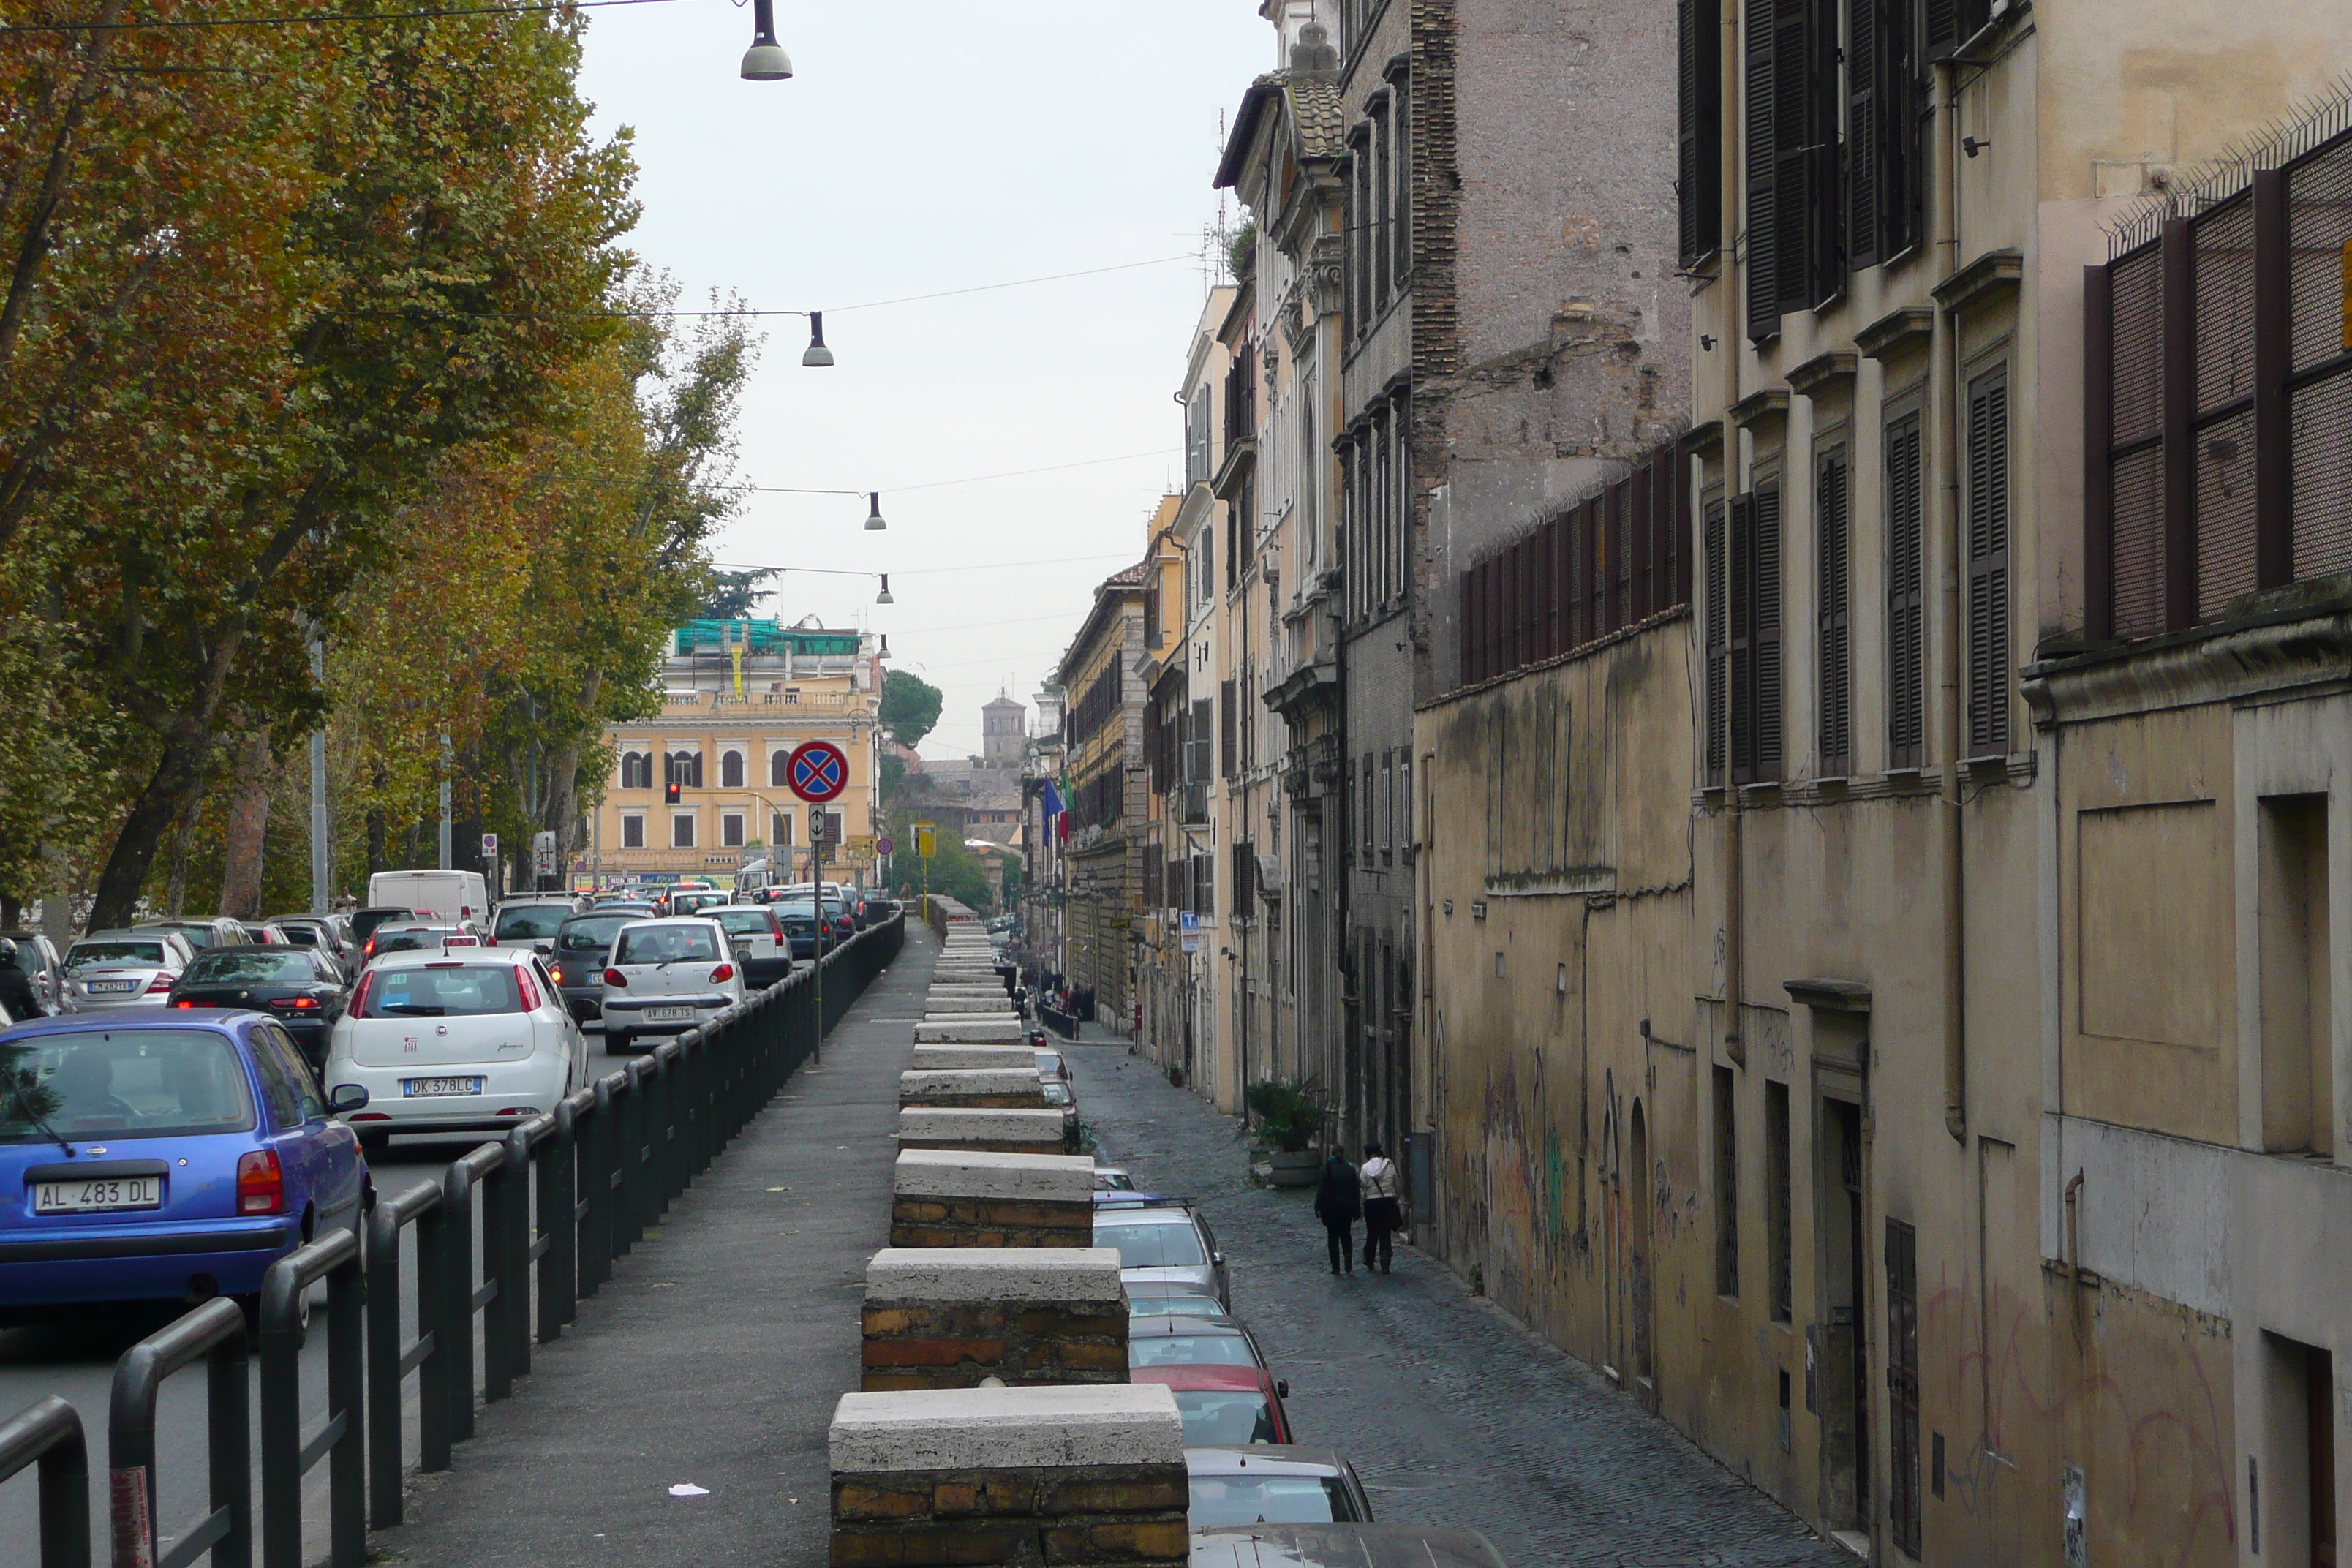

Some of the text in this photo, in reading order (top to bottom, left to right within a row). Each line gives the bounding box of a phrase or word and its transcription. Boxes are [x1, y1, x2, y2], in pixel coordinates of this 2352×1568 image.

[1184, 914, 1195, 926] T
[446, 938, 475, 946] TAXI
[647, 1007, 690, 1017] AV 678 TS
[412, 1079, 472, 1093] DK 378LC
[42, 1180, 154, 1206] AL 483 DL
